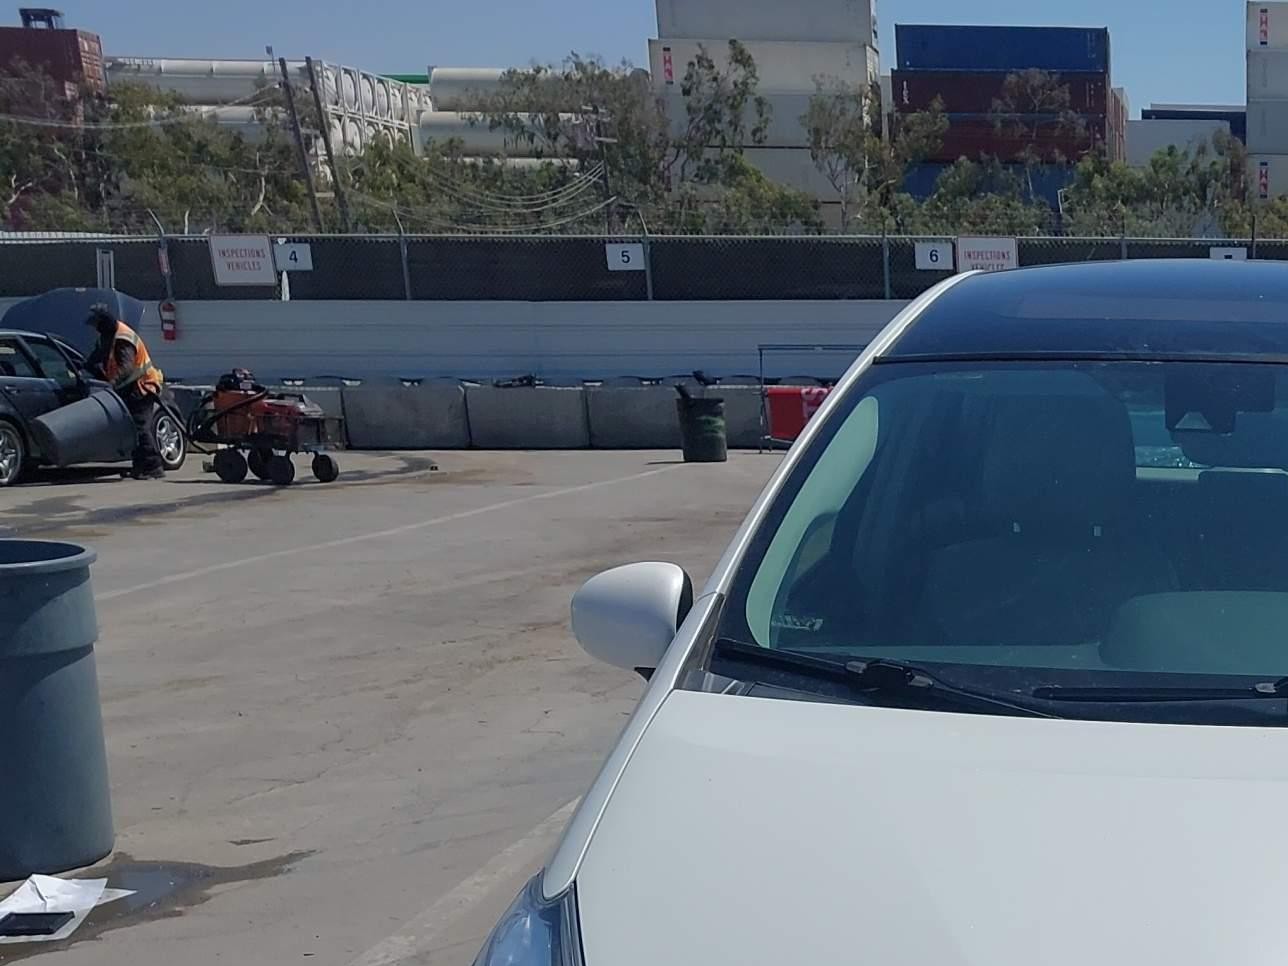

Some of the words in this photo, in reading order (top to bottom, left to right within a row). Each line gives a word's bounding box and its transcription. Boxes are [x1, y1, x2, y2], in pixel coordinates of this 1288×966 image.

[218, 248, 266, 258] INSPECTIONS
[289, 250, 298, 263] 4
[621, 250, 631, 264] 5
[929, 249, 939, 263] 6
[964, 250, 1010, 259] INSPECTIONS
[227, 261, 262, 271] VEHICLES
